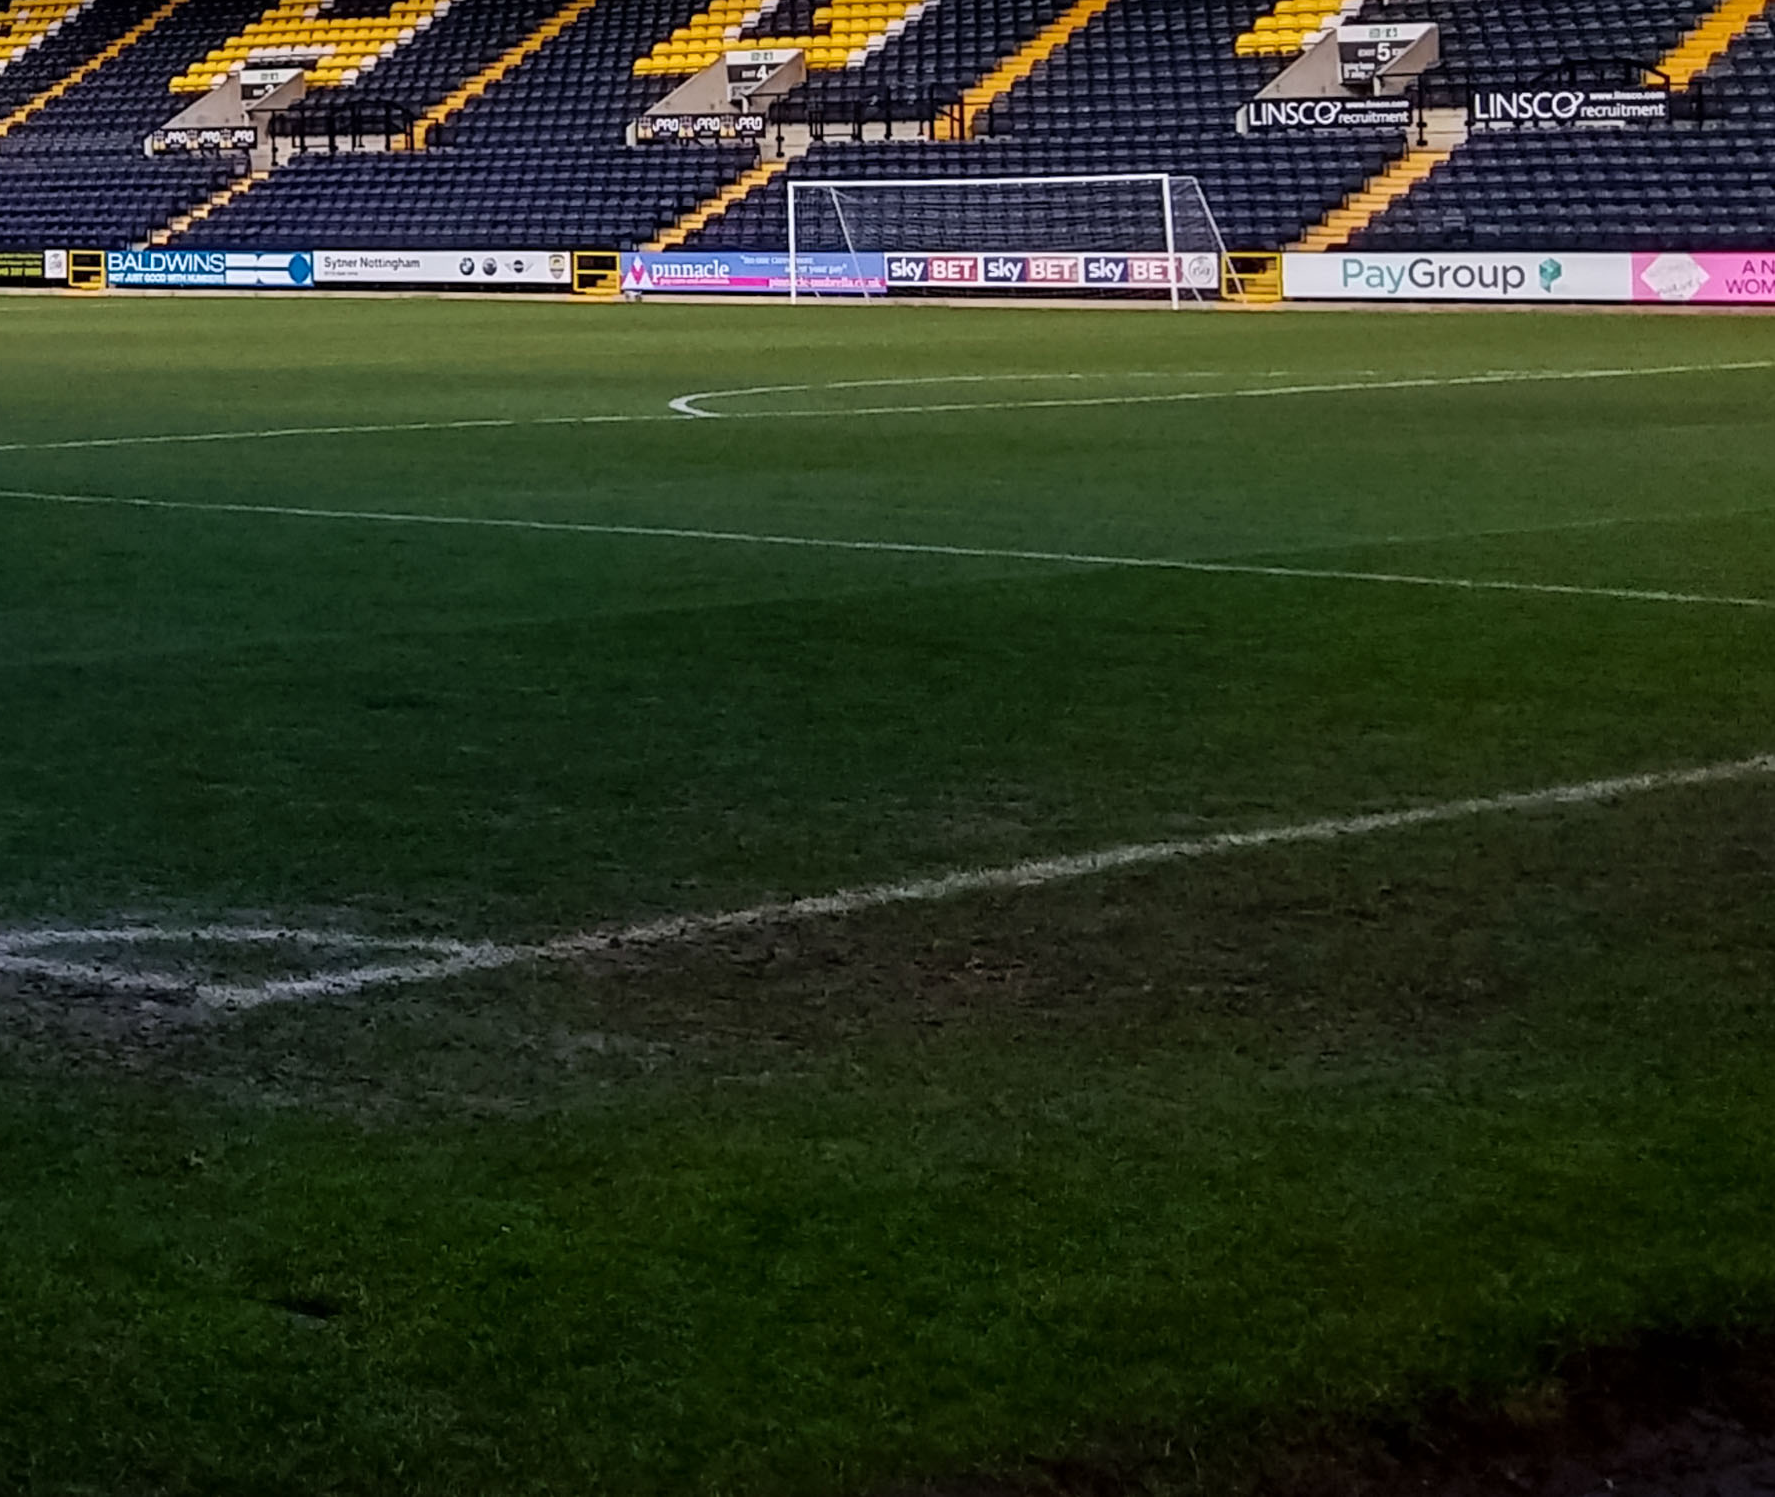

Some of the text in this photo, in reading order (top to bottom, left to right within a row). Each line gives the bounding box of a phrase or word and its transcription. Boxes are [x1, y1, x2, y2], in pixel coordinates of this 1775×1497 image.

[1376, 42, 1391, 61] 5
[1249, 101, 1342, 126] LINSCO
[1474, 91, 1585, 119] LINSCO
[1580, 102, 1666, 117] recruitment
[1338, 110, 1409, 124] recruitment
[108, 253, 225, 273] BALDWINS
[324, 256, 421, 271] Sytner Nottingham
[651, 259, 730, 283] pinnacle
[890, 259, 975, 282] sky BET
[987, 259, 1073, 282] sky BET
[1087, 259, 1174, 282] sky BET
[1342, 257, 1526, 295] PayGroup
